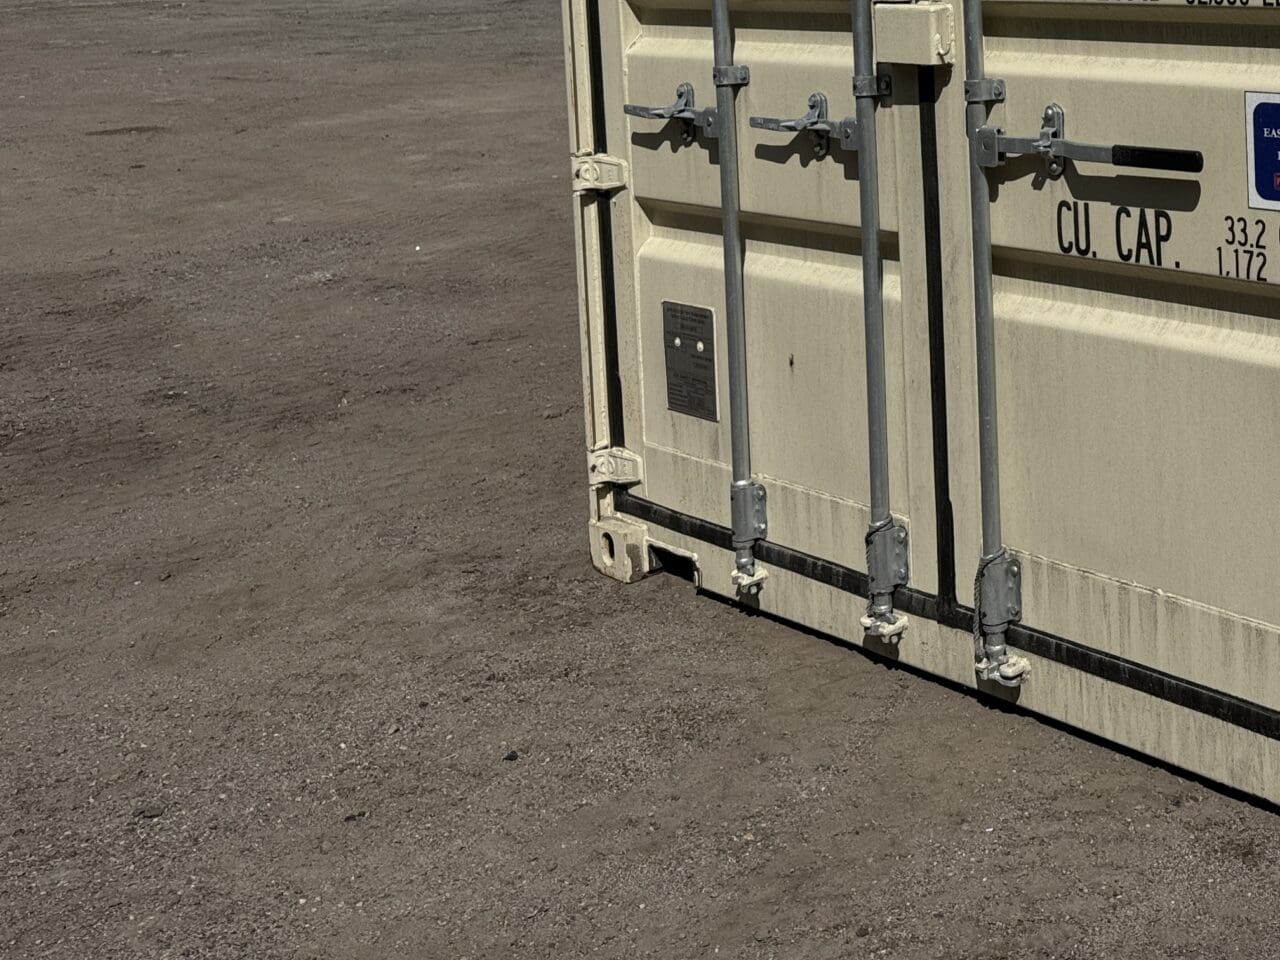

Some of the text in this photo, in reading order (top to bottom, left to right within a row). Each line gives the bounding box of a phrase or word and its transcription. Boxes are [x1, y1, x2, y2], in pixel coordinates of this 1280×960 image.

[1057, 200, 1097, 258] CU.
[1115, 206, 1181, 268] CAP.
[1224, 215, 1266, 250] 33.2
[1216, 247, 1267, 282] 1,172
